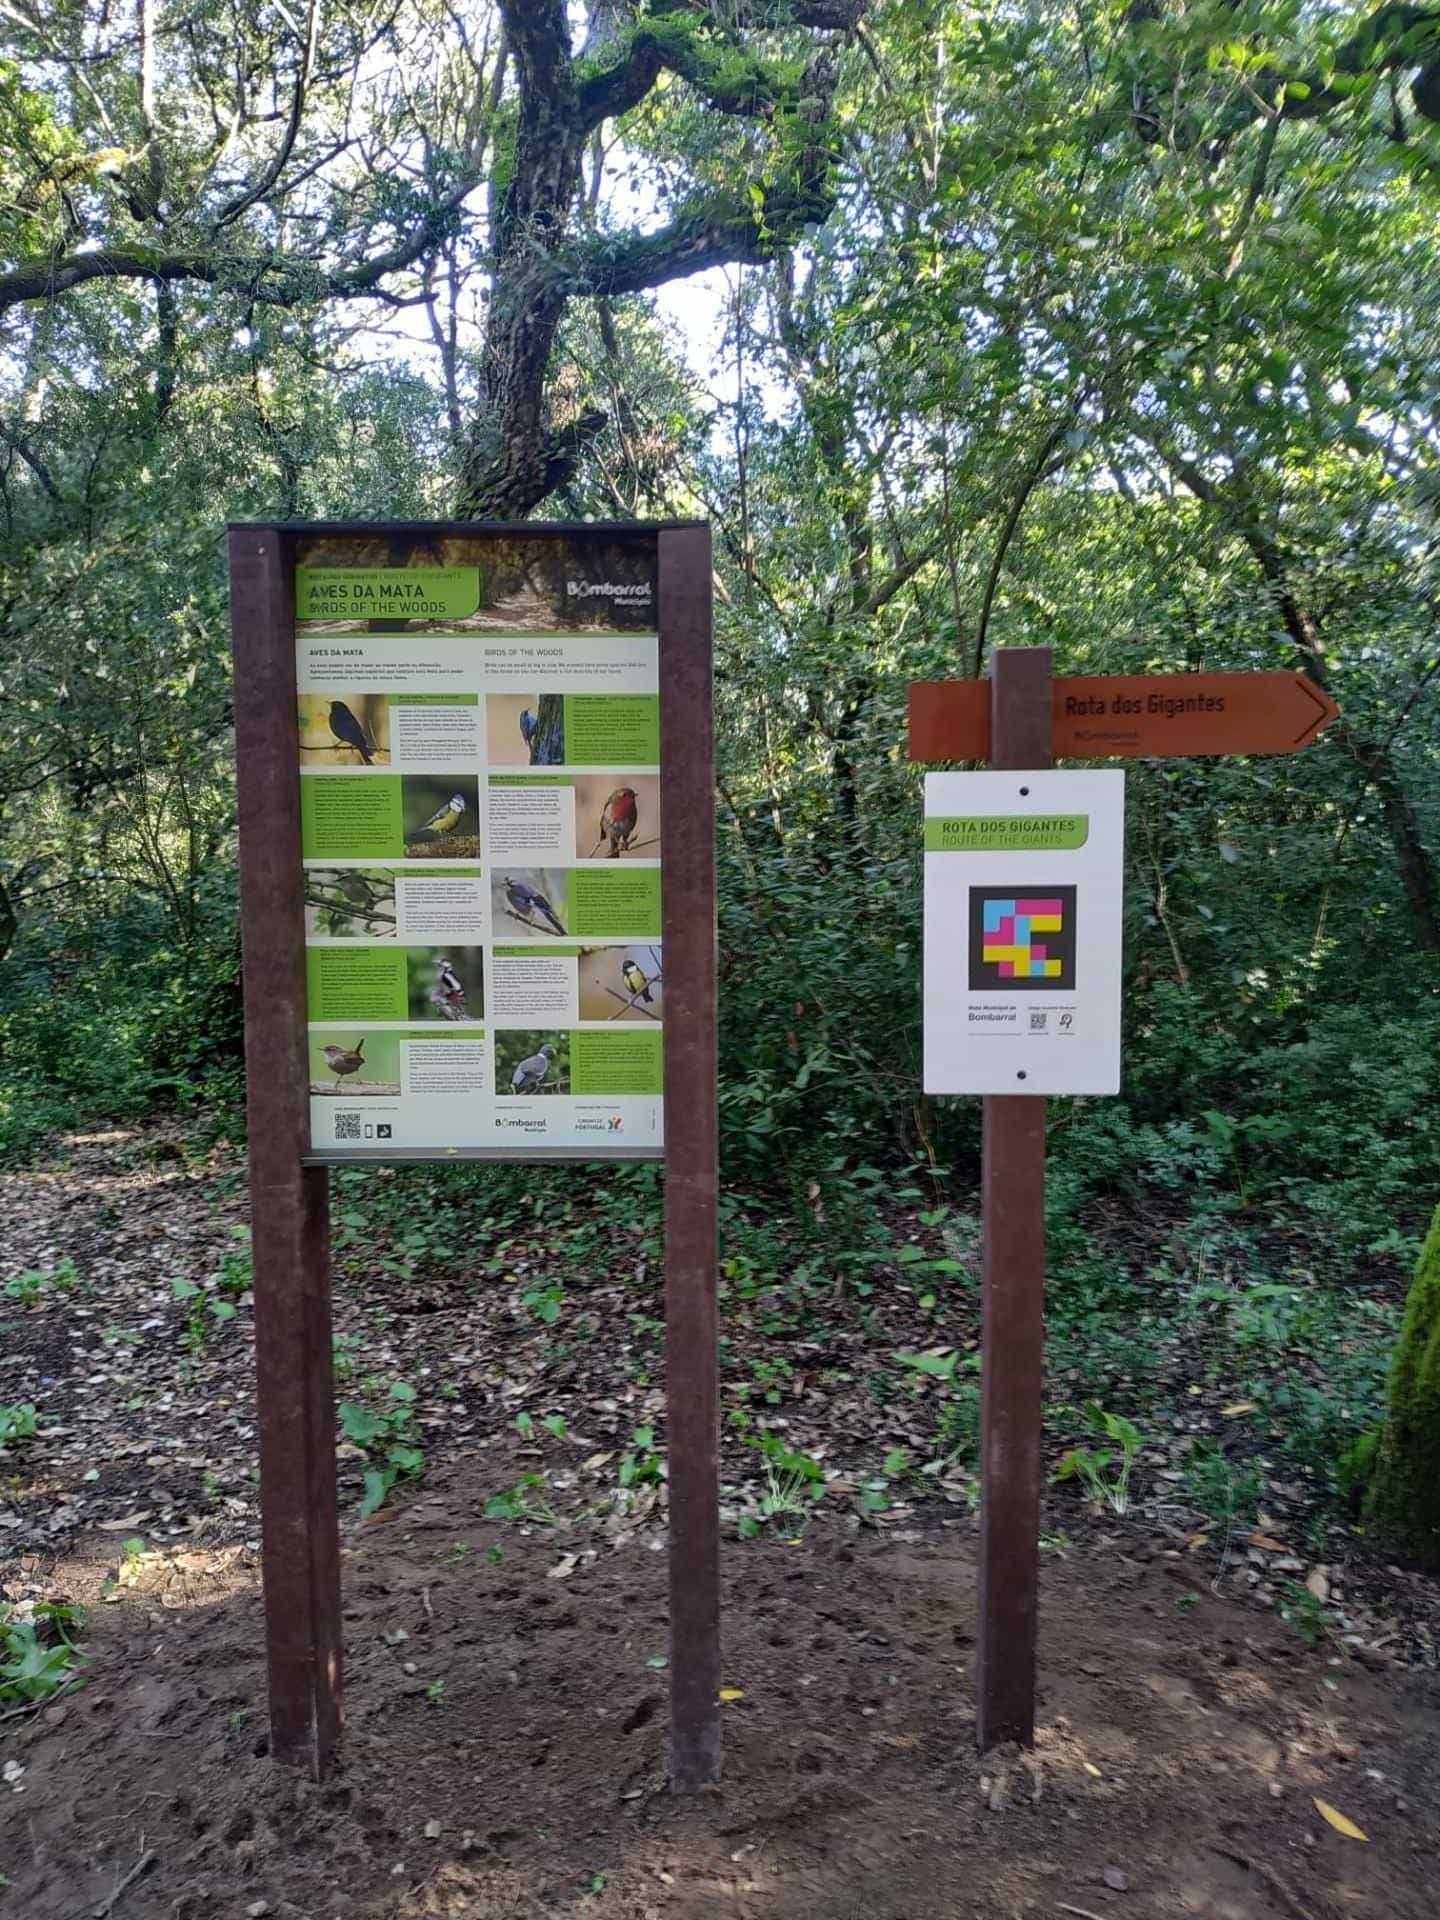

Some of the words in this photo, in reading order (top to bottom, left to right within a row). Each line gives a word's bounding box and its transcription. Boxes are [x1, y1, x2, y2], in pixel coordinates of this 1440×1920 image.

[309, 584, 348, 598] AVES
[353, 584, 374, 598] DA
[379, 584, 425, 598] MATA
[309, 601, 347, 613] BIRDS
[351, 601, 368, 613] OF
[371, 601, 396, 613] THE
[399, 600, 447, 613] WOODS
[520, 648, 534, 656] THE
[537, 648, 563, 656] WOODS
[1065, 695, 1106, 717] Rota
[1111, 694, 1142, 715] dos
[1147, 693, 1225, 718] Gigantes
[942, 821, 977, 833] ROTA
[980, 821, 1007, 833] DOS
[1009, 820, 1076, 833] GIGANTES
[968, 1012, 1017, 1021] Bombarral
